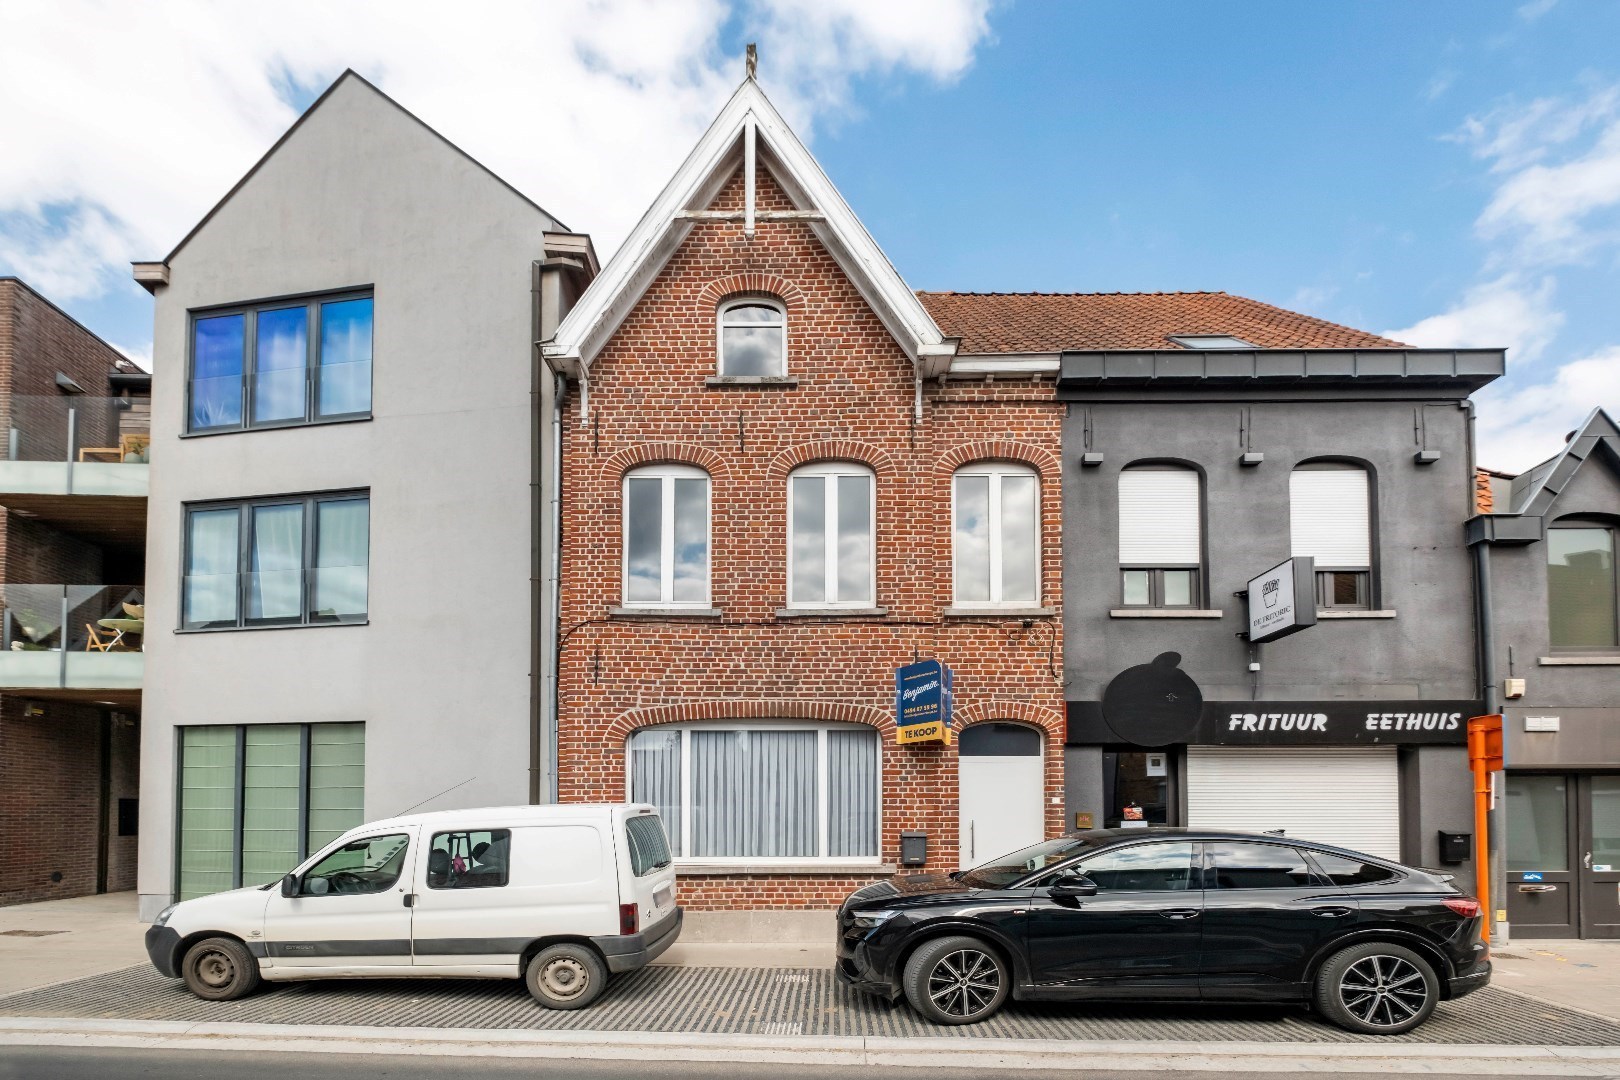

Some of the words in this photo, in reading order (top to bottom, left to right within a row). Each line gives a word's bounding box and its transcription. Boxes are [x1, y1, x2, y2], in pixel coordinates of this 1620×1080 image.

[1228, 713, 1328, 732] FRITUUR
[1365, 712, 1462, 731] EETHUIS
[905, 730, 912, 738] TE
[914, 727, 937, 737] KOOP
